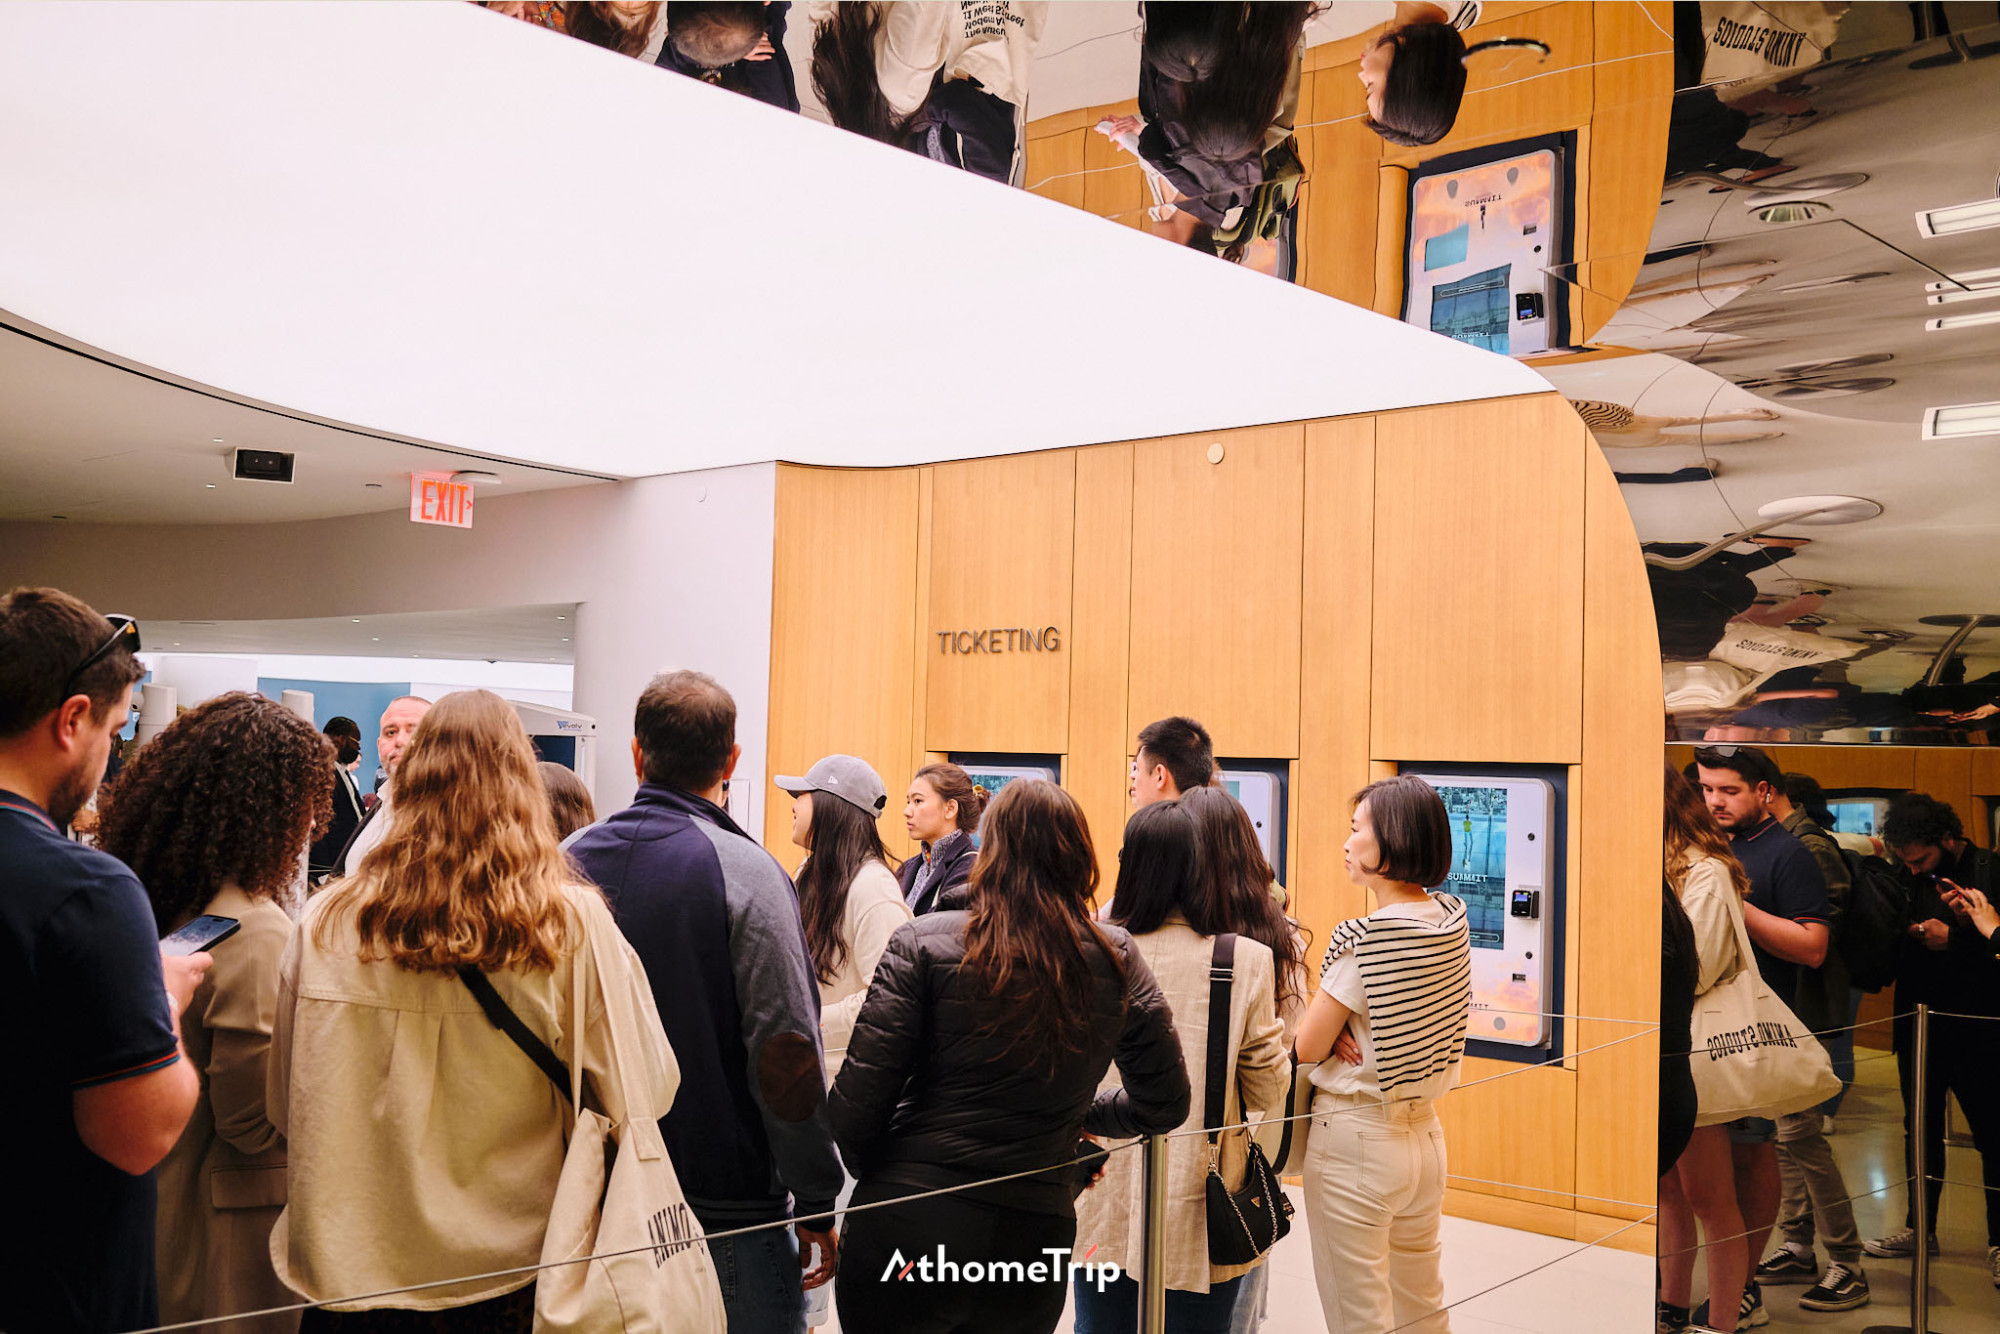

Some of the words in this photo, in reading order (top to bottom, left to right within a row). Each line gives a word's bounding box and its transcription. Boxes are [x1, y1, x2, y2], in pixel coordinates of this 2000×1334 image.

[1713, 16, 1770, 54] STUDIOS
[1764, 30, 1807, 67] ANIMO
[421, 480, 469, 525] EXIT
[936, 626, 1060, 655] TICKETING
[647, 1202, 691, 1269] ANIMO
